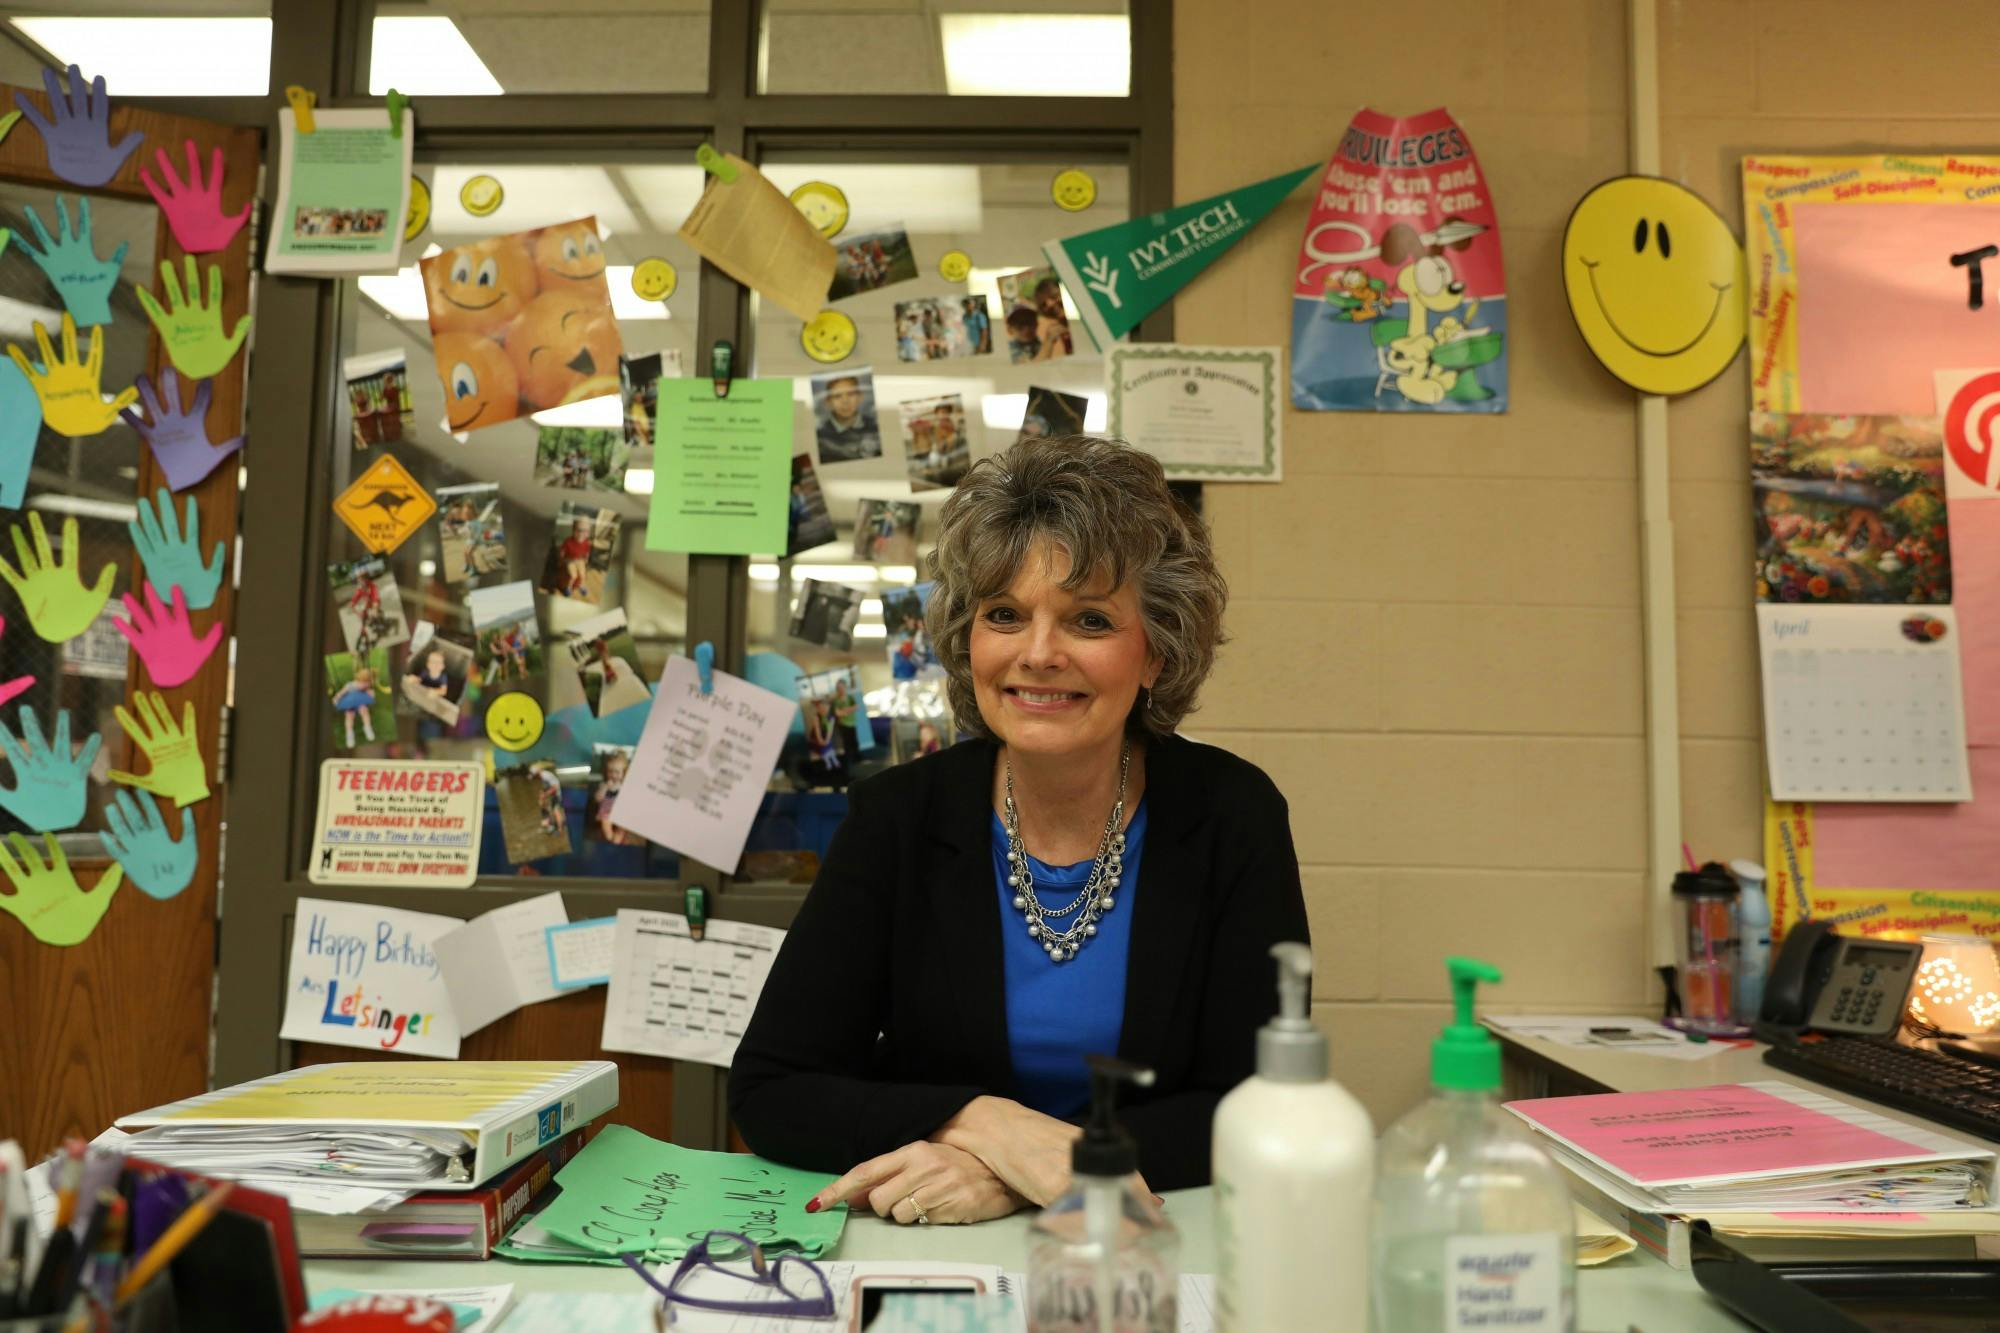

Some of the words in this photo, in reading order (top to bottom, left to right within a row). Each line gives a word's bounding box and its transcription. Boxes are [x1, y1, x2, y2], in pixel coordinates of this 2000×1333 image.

[1438, 166, 1477, 191] and
[1765, 168, 1860, 200] Compassion
[1833, 176, 1937, 201] Self-Discipline
[1374, 189, 1428, 216] lose
[1128, 235, 1169, 271] IVY
[1170, 200, 1240, 246] TECH
[1137, 243, 1202, 282] COMMUNITY
[737, 702, 767, 729] Day
[338, 769, 471, 794] TEENAGERS
[1859, 912, 1969, 936] Self-Discipline
[307, 913, 367, 978] Happy
[375, 920, 441, 982] Birthday
[321, 979, 435, 1050] Letsinger
[1647, 1137, 1729, 1149] College
[1684, 1125, 1795, 1139] Computer
[1734, 1131, 1795, 1143] Early
[502, 1180, 530, 1227] PERSONAL
